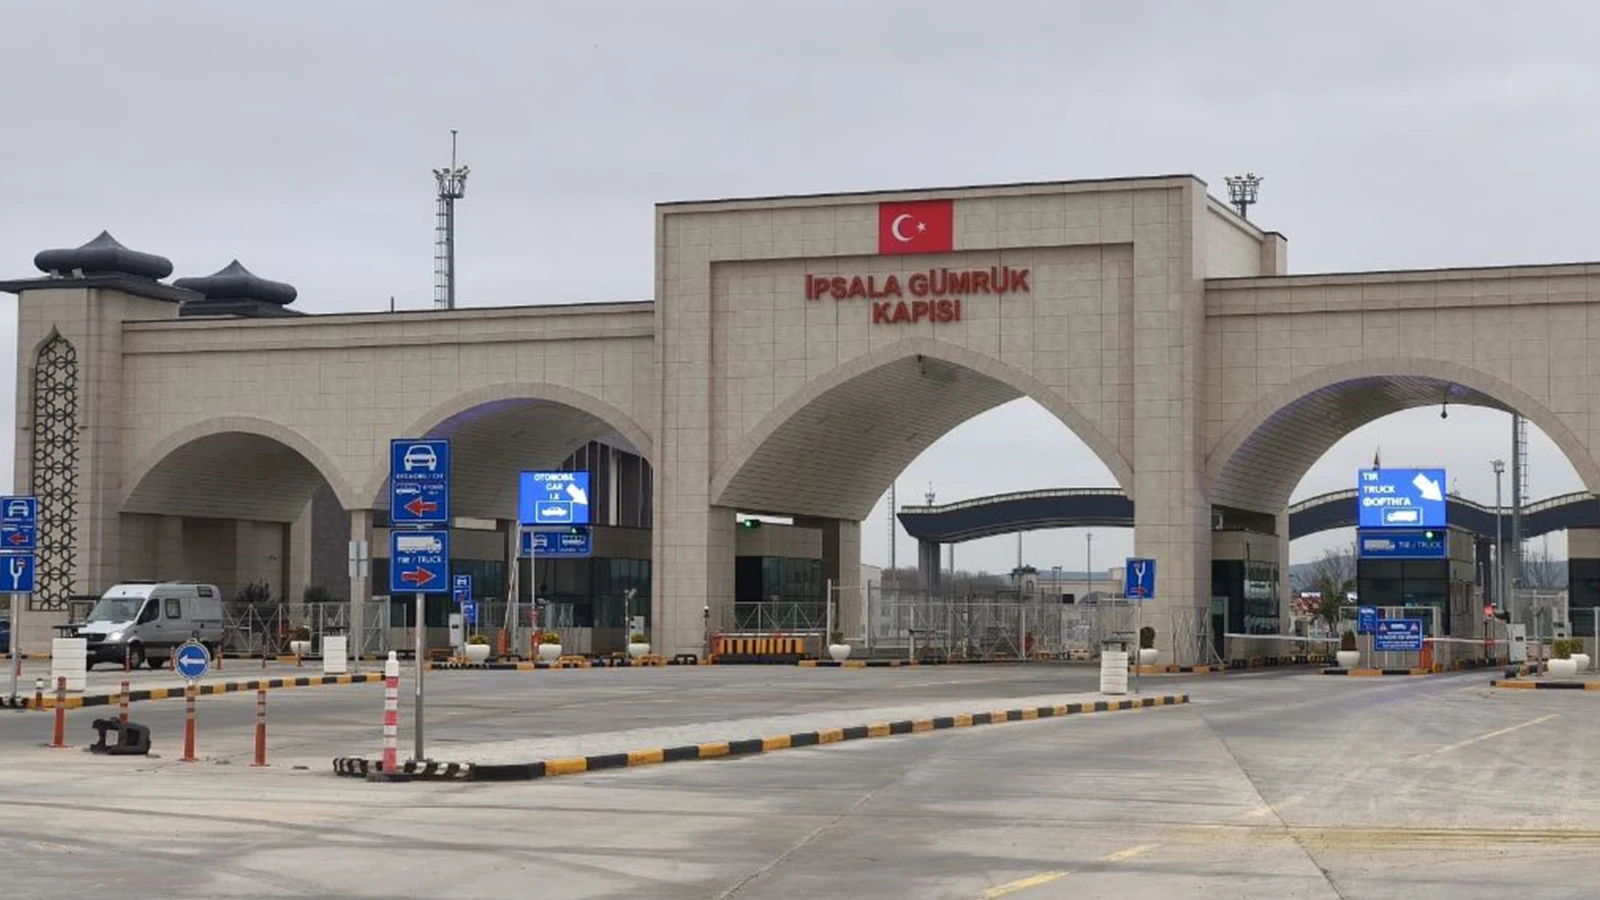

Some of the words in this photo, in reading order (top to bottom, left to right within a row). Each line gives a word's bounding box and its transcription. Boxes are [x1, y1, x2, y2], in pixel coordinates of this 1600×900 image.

[908, 265, 1030, 296] GÜMRÜK
[1363, 472, 1379, 481] TIR
[545, 482, 564, 491] CAR
[1363, 485, 1396, 494] TRUCK
[417, 555, 442, 563] TRUCK
